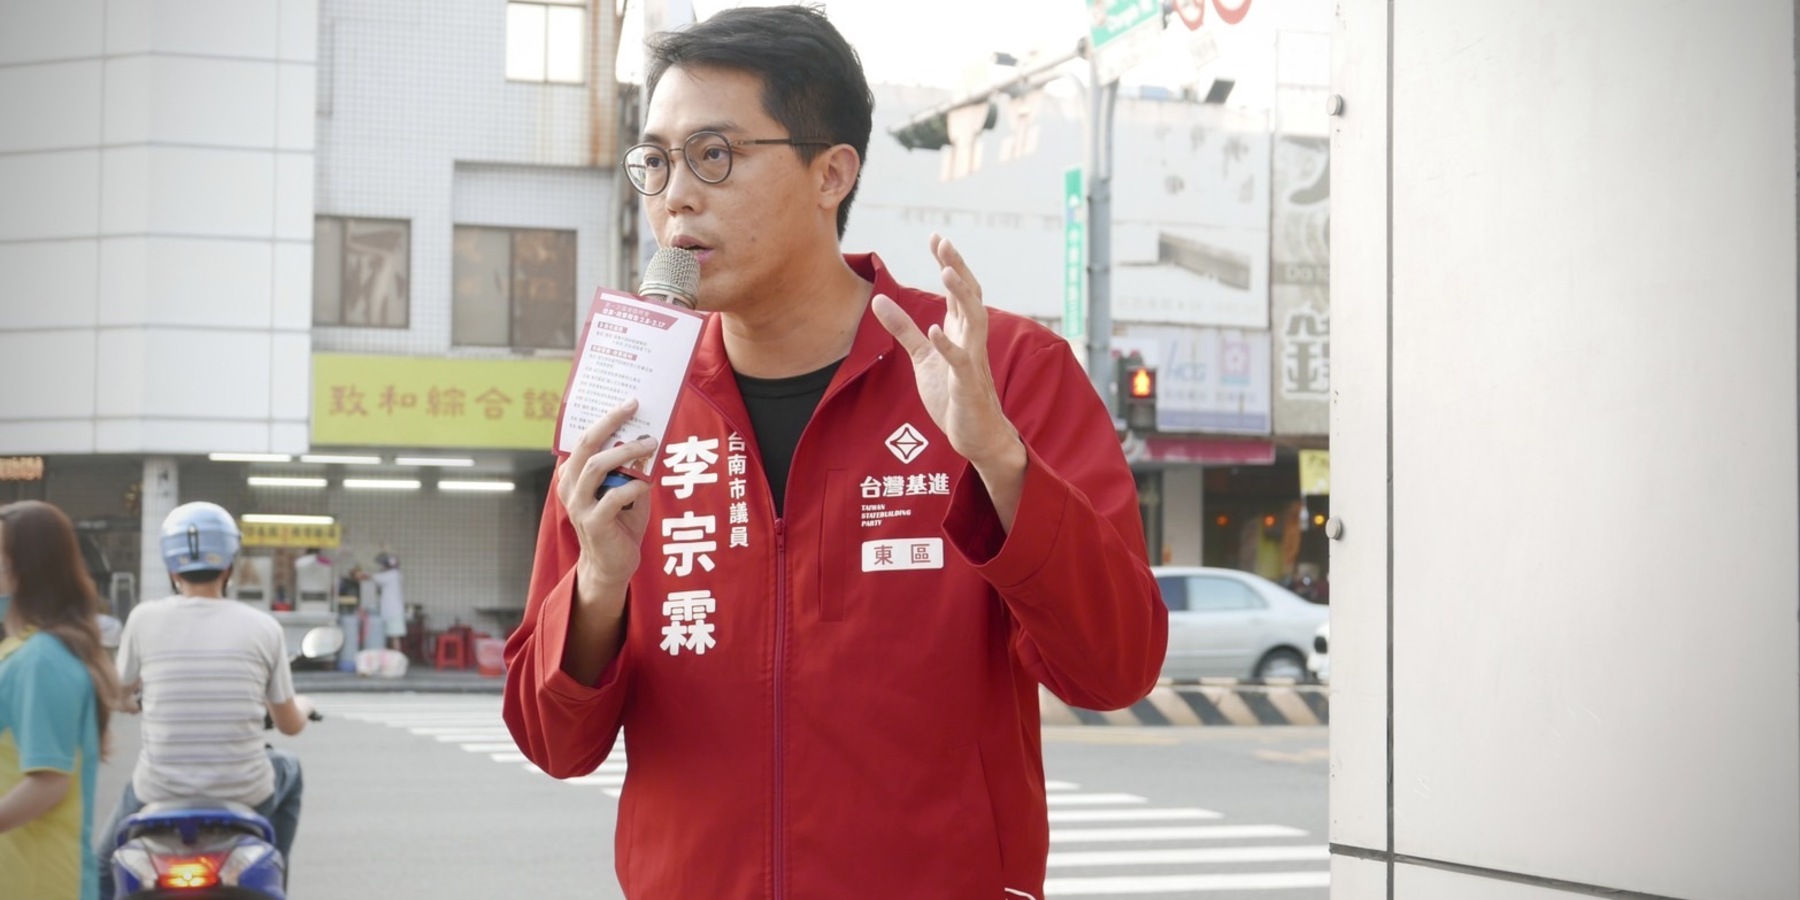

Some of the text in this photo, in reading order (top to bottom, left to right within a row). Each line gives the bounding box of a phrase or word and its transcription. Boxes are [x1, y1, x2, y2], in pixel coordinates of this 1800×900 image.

[727, 431, 749, 548] 台南市議員
[860, 473, 950, 498] 台灣基進
[861, 509, 911, 519] STATEBUILDING
[861, 519, 882, 527] PARTY
[659, 435, 719, 656] 李宗霖
